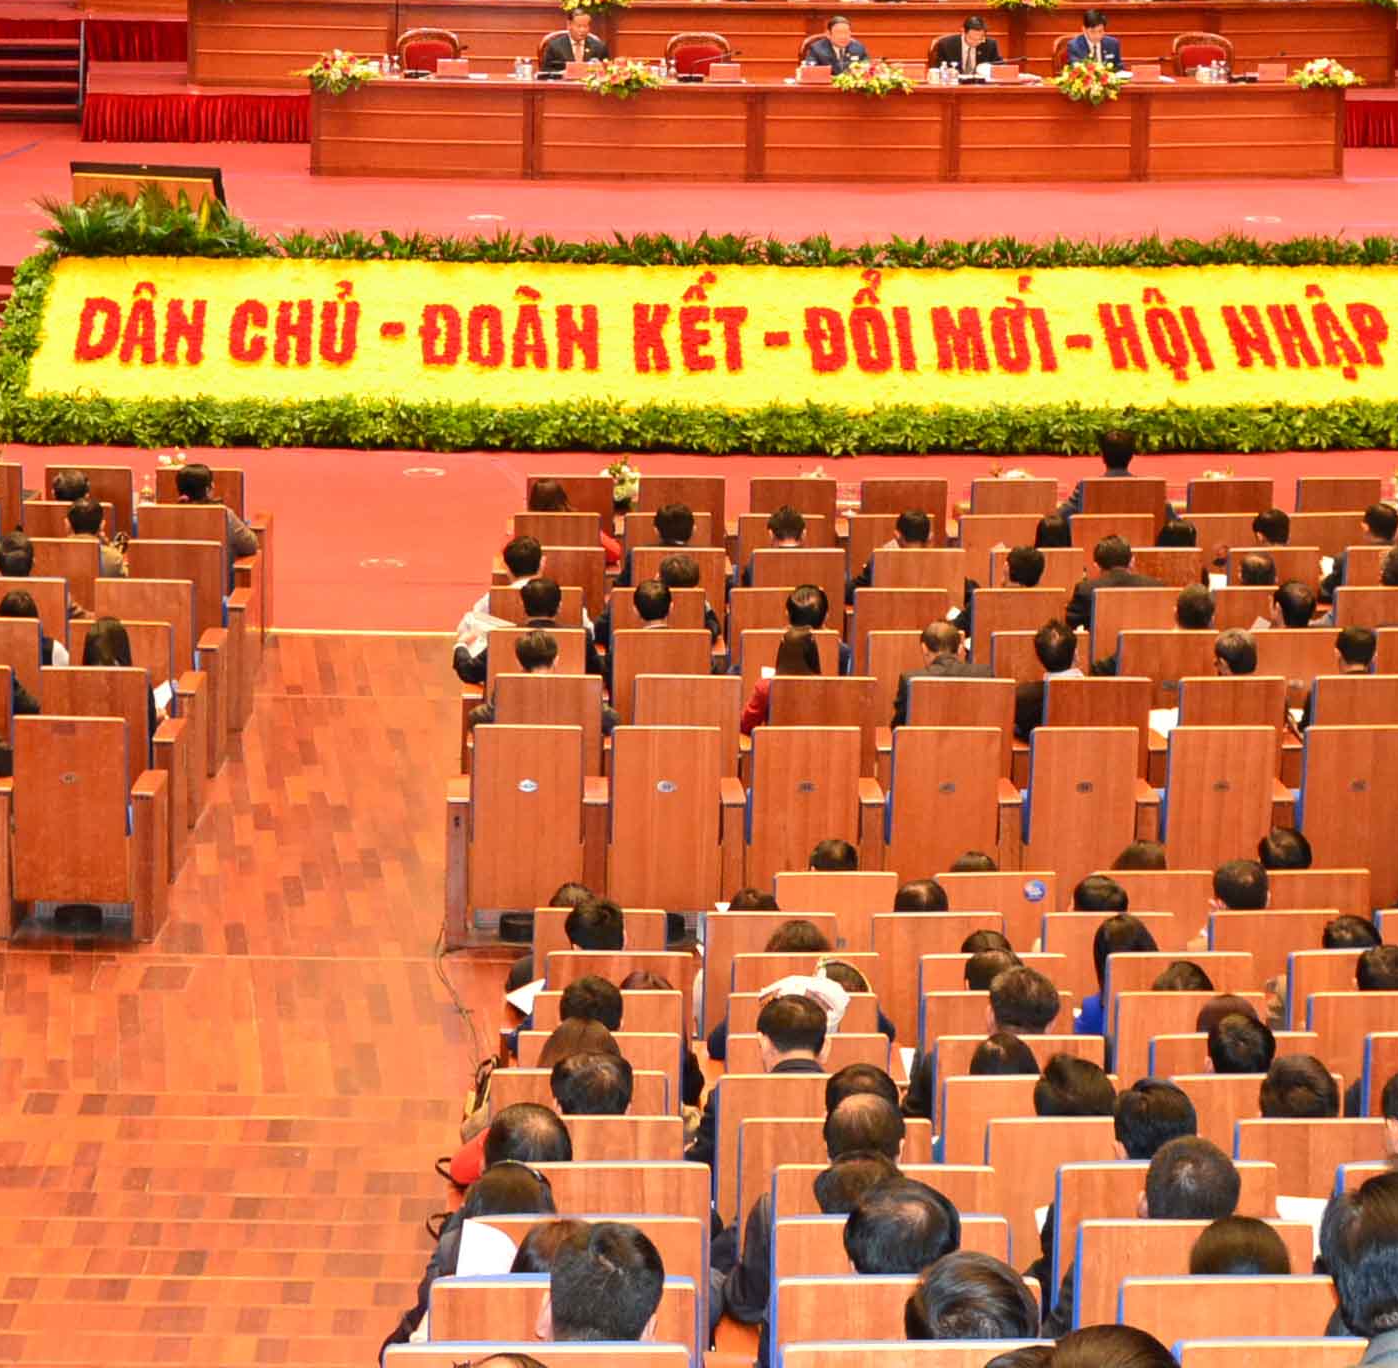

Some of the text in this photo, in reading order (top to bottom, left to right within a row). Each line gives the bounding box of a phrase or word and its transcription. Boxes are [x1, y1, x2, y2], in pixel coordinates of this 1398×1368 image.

[73, 282, 206, 365] DÂN
[229, 280, 359, 366] CHỦ
[419, 285, 601, 370] ĐOÀN
[632, 272, 748, 373] KẾT
[804, 270, 917, 373] ĐỔI
[931, 276, 1058, 373] MỚI
[1095, 288, 1214, 380] HỘI
[1220, 285, 1389, 379] NHẬP
